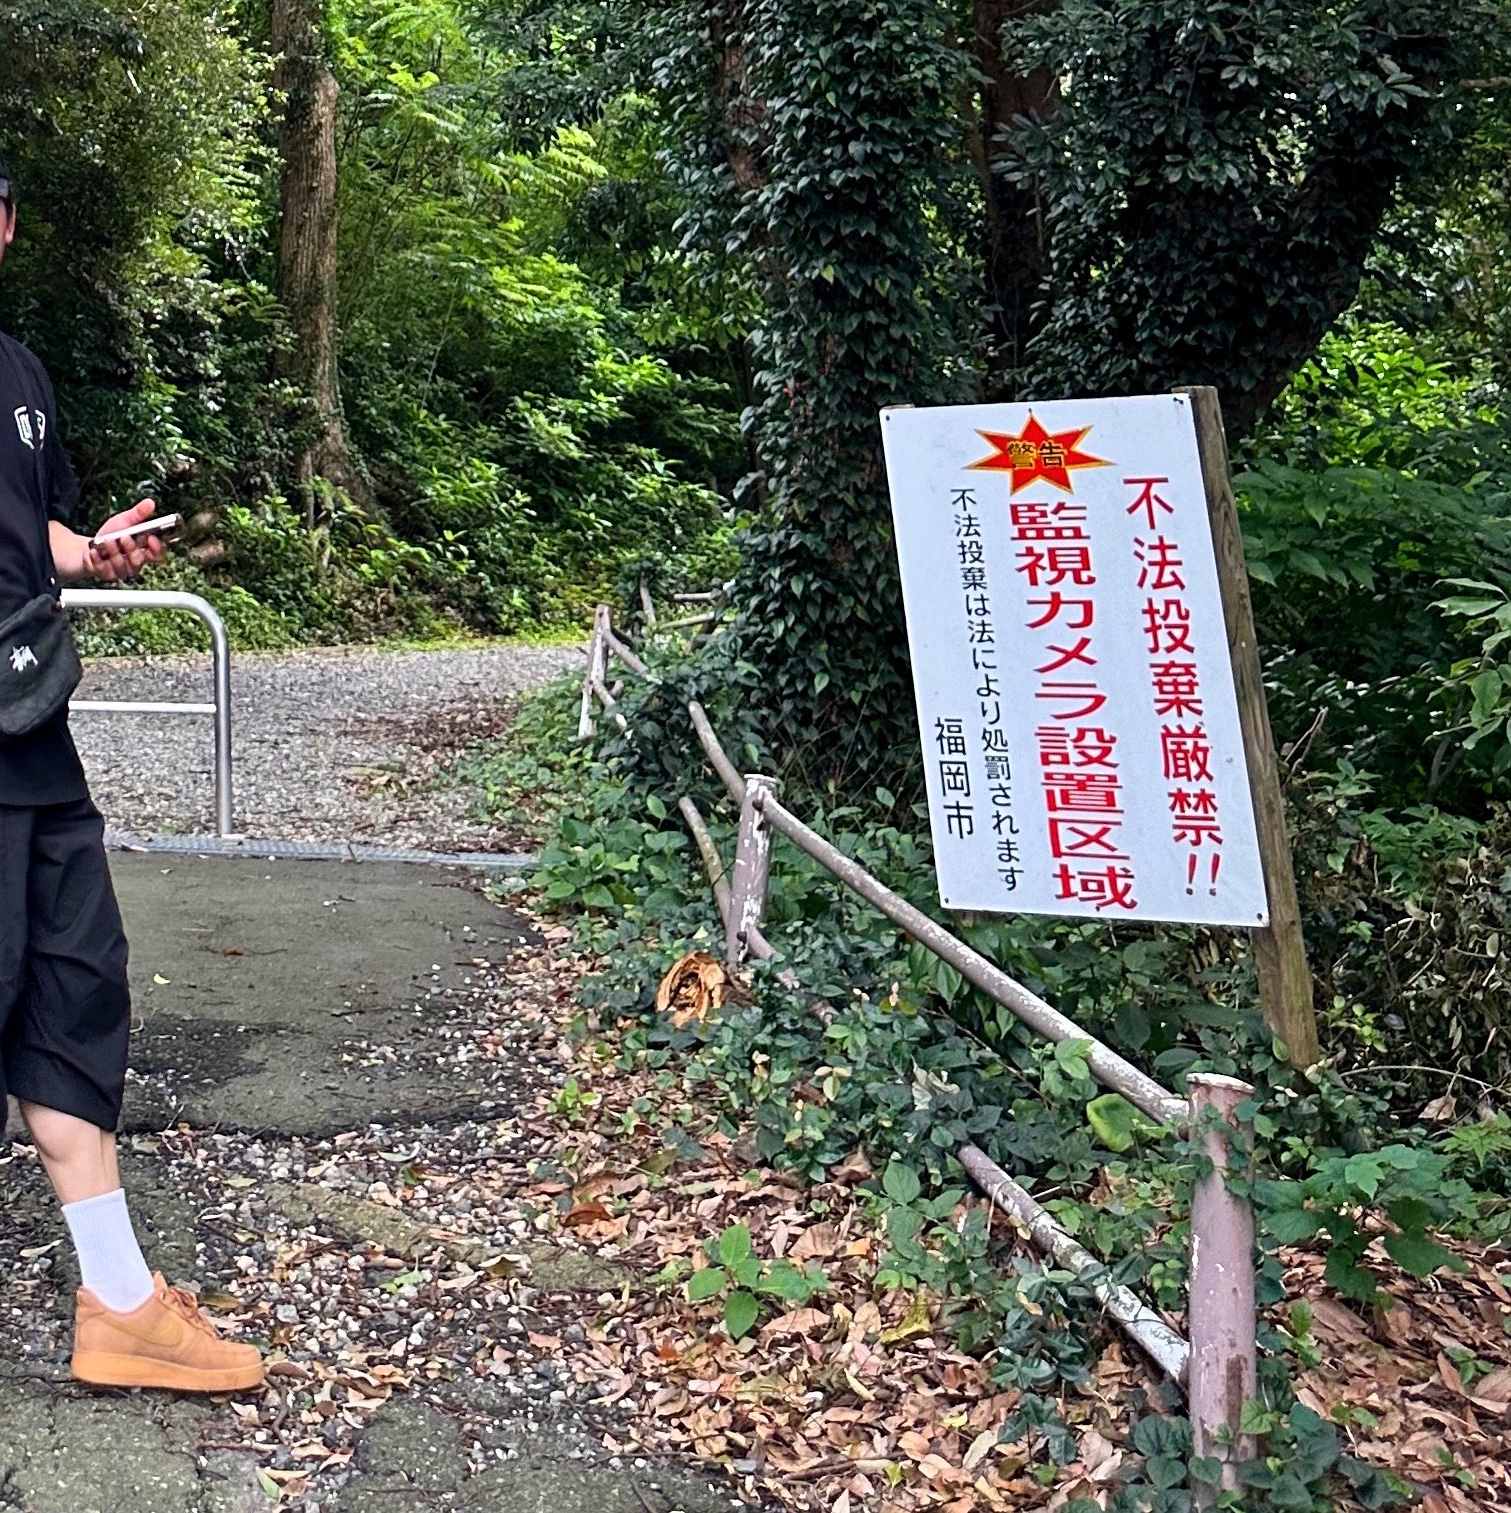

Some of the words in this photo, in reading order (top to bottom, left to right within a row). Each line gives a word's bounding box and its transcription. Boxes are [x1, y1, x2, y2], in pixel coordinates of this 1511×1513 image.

[1007, 440, 1068, 469] 警告
[934, 716, 975, 840] 福岡市
[950, 488, 1025, 892] 不法投棄は法により処罰されます
[1009, 501, 1138, 910] 監視カメラ設置区域
